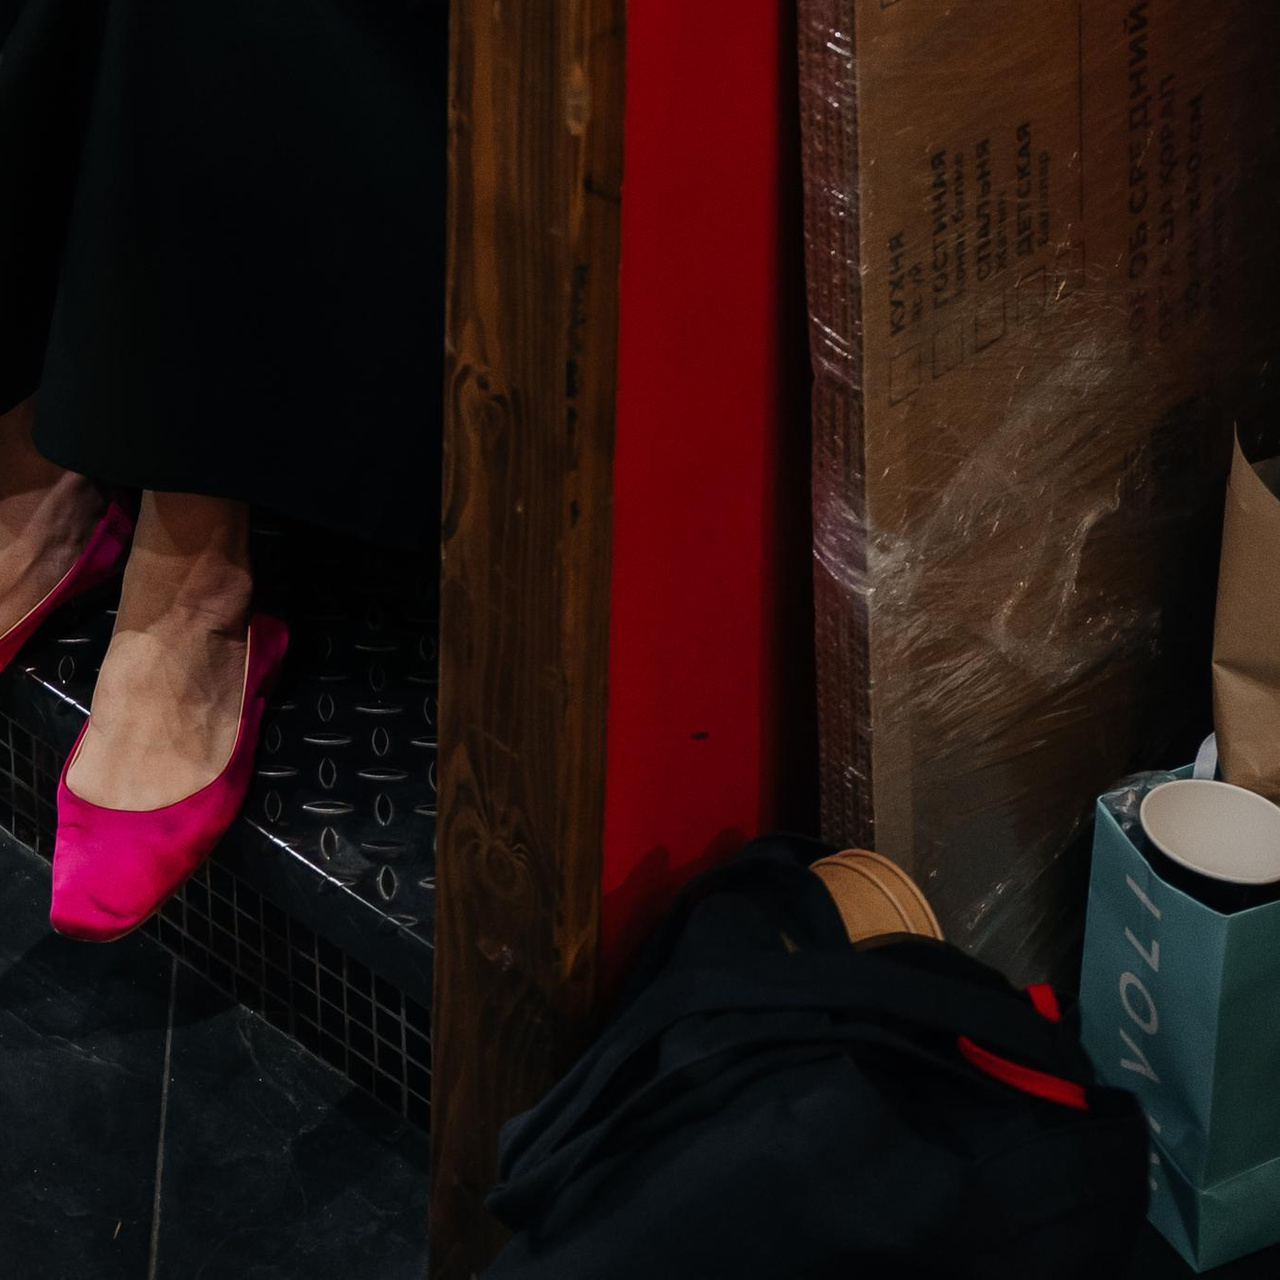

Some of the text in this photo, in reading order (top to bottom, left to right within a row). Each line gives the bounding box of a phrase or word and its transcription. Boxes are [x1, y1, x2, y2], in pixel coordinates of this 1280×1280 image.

[1121, 0, 1152, 215] СРЕДНИЙ
[930, 149, 949, 309] ГОСТИНАЯ
[974, 138, 991, 282] СПАЛЬНЯ
[1014, 121, 1033, 258] ДЕТСКАЯ
[887, 230, 905, 336] КУХНЯ
